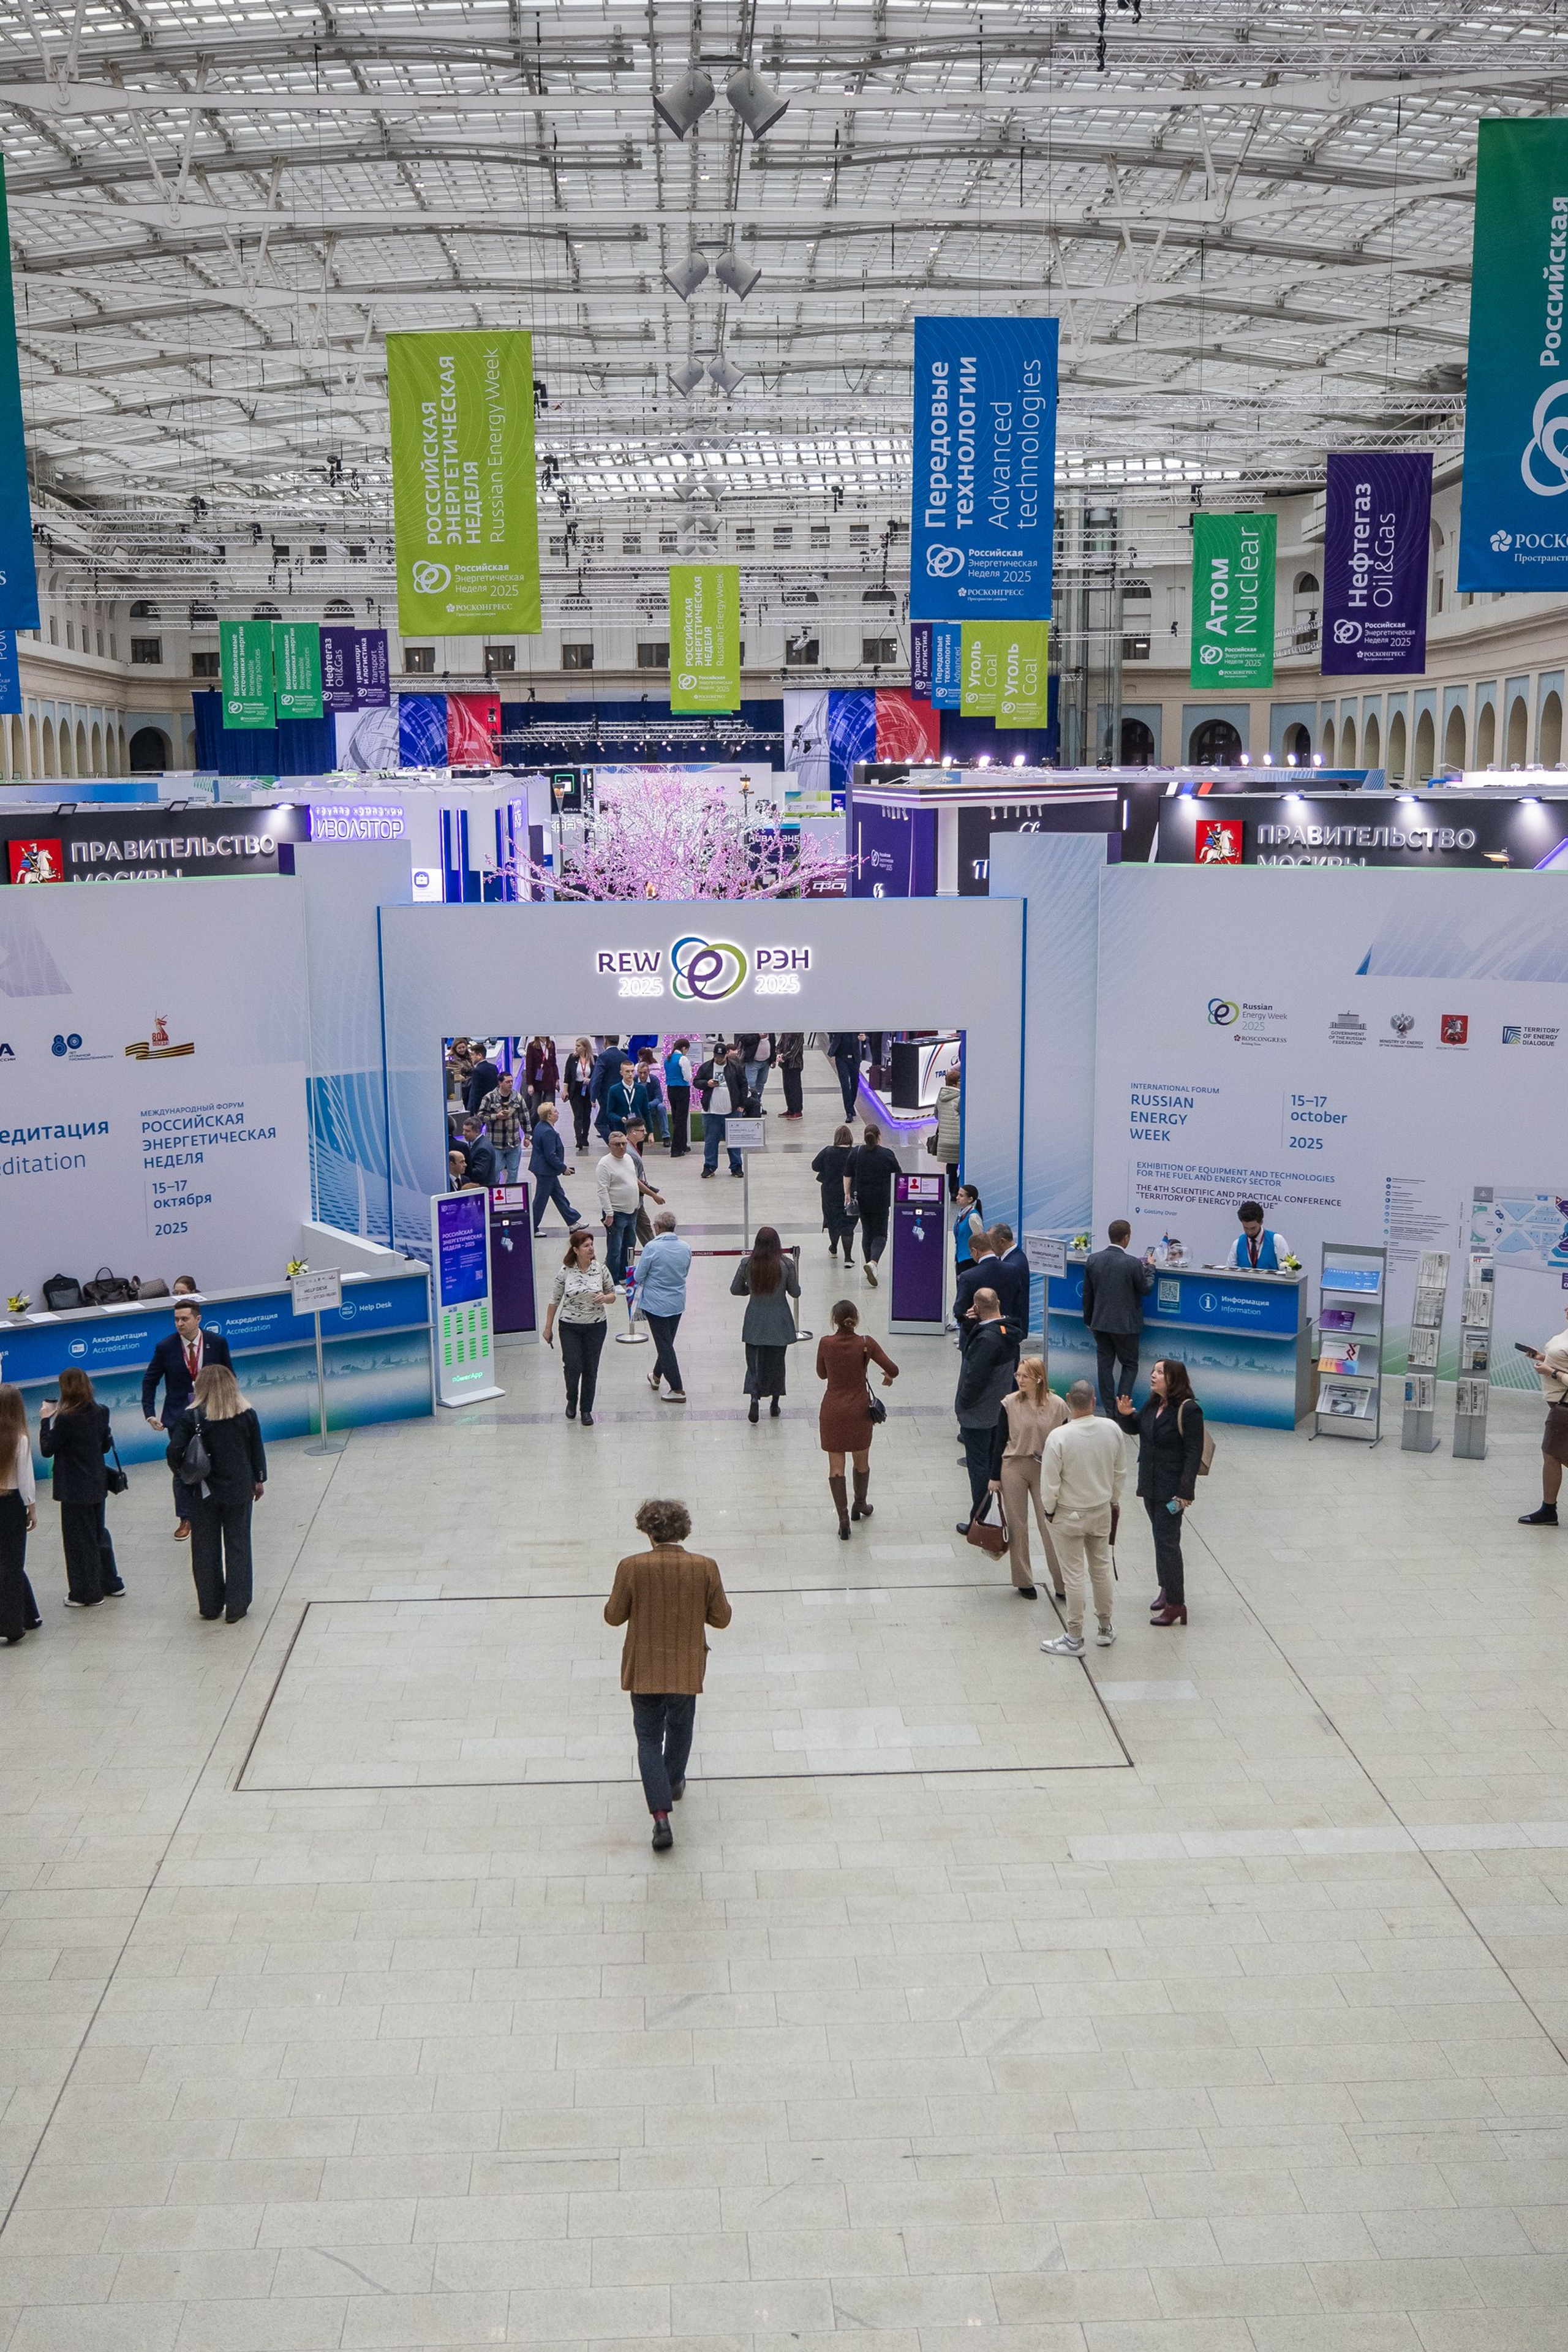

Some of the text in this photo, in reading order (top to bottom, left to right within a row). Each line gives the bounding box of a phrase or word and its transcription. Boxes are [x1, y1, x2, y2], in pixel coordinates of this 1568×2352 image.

[1539, 197, 1568, 366] Российская
[439, 355, 462, 545] ЭНЕРГЕТИЧЕСКАЯ
[483, 347, 506, 543] Russian Energy Week
[925, 361, 952, 528] Передовые
[957, 356, 977, 530] технологии
[1015, 359, 1046, 529] technologies
[421, 401, 442, 545] РОССИЙСКАЯ
[988, 402, 1012, 530] Advanced
[463, 461, 483, 544] НЕДЕЛЯ
[1349, 483, 1374, 607] Нефтегаз
[1515, 533, 1568, 548] РОСК
[968, 548, 1023, 557] Российская
[1373, 513, 1395, 608] Oil&Gas
[454, 563, 509, 572] Российская
[968, 559, 1038, 570] Энергетическая
[454, 573, 524, 584] Энергетическая
[968, 569, 1031, 582] Неделя 2025
[1235, 526, 1259, 634] Nuclear
[455, 584, 519, 597] Неделя 2025
[715, 573, 724, 598] Week
[456, 602, 513, 612] РОСКОНГРЕСС
[716, 599, 726, 630] Energy
[695, 576, 703, 666] ЭНЕРГЕТИЧЕСКАЯ
[684, 597, 693, 666] РОССИЙСКАЯ
[704, 626, 714, 666] НЕДЕЛЯ
[1390, 638, 1411, 647] 2025
[325, 638, 334, 687] Нефтегаз
[377, 640, 386, 671] logistics
[968, 641, 981, 688] Уголь
[984, 655, 997, 687] Coal
[1004, 643, 1019, 696] Уголь
[1022, 659, 1037, 696] Coal
[316, 819, 402, 839] ИЗОЛЯТОР
[1257, 824, 1476, 850] ПРАВИТЕЛЬСТВО
[71, 834, 276, 862] ПРАВИТЕЛЬСТВО
[598, 952, 660, 973] REW
[756, 949, 809, 970] РЭН
[619, 978, 662, 996] 2025
[755, 976, 799, 993] 2025
[1242, 1012, 1267, 1020] Energy
[1242, 1021, 1265, 1031] 2025
[1131, 1083, 1190, 1093] INTERNATIONAL
[140, 1102, 244, 1117] МЕЖДУНАРОДНЫЙ ФОРУМ
[1131, 1094, 1194, 1109] RUSSIAN
[142, 1112, 244, 1133] РОССИЙСКАЯ
[1131, 1111, 1188, 1125] ENERGY
[1291, 1111, 1348, 1124] october
[0, 1121, 109, 1146] едитация
[143, 1127, 277, 1152] ЭНЕРГЕТИЧЕСКАЯ
[1130, 1128, 1170, 1142] WEEK
[1289, 1136, 1324, 1150] 2025
[0, 1152, 86, 1175] ditation
[143, 1152, 204, 1169] НЕДЕЛЯ
[1137, 1162, 1183, 1172] EXHIBITION
[1198, 1166, 1248, 1177] EQUIPMENT
[1270, 1172, 1335, 1183] TECHNOLOGIES
[1215, 1175, 1247, 1185] ENERGY
[1249, 1178, 1281, 1187] SECTOR
[153, 1193, 213, 1210] октября
[1171, 1186, 1215, 1196] SCIENTIFIC
[1237, 1191, 1282, 1202] PRACTICAL
[1284, 1196, 1341, 1207] CONFERENCE
[1198, 1197, 1231, 1206] ENERGY
[155, 1221, 189, 1237] 2025
[442, 1228, 473, 1238] РОССИЙСКАЯ
[442, 1234, 483, 1245] ЭНЕРГЕТИЧЕСКАЯ
[442, 1243, 461, 1252] НЕДЕЛЯ
[1221, 1295, 1270, 1306] Информация
[225, 1312, 278, 1326] Аккредитация
[1221, 1305, 1262, 1316] Information
[92, 1331, 148, 1344] Аккредитация
[226, 1322, 271, 1335] Accreditation
[93, 1341, 140, 1354] Accreditation
[452, 1371, 483, 1383] PowerApp
